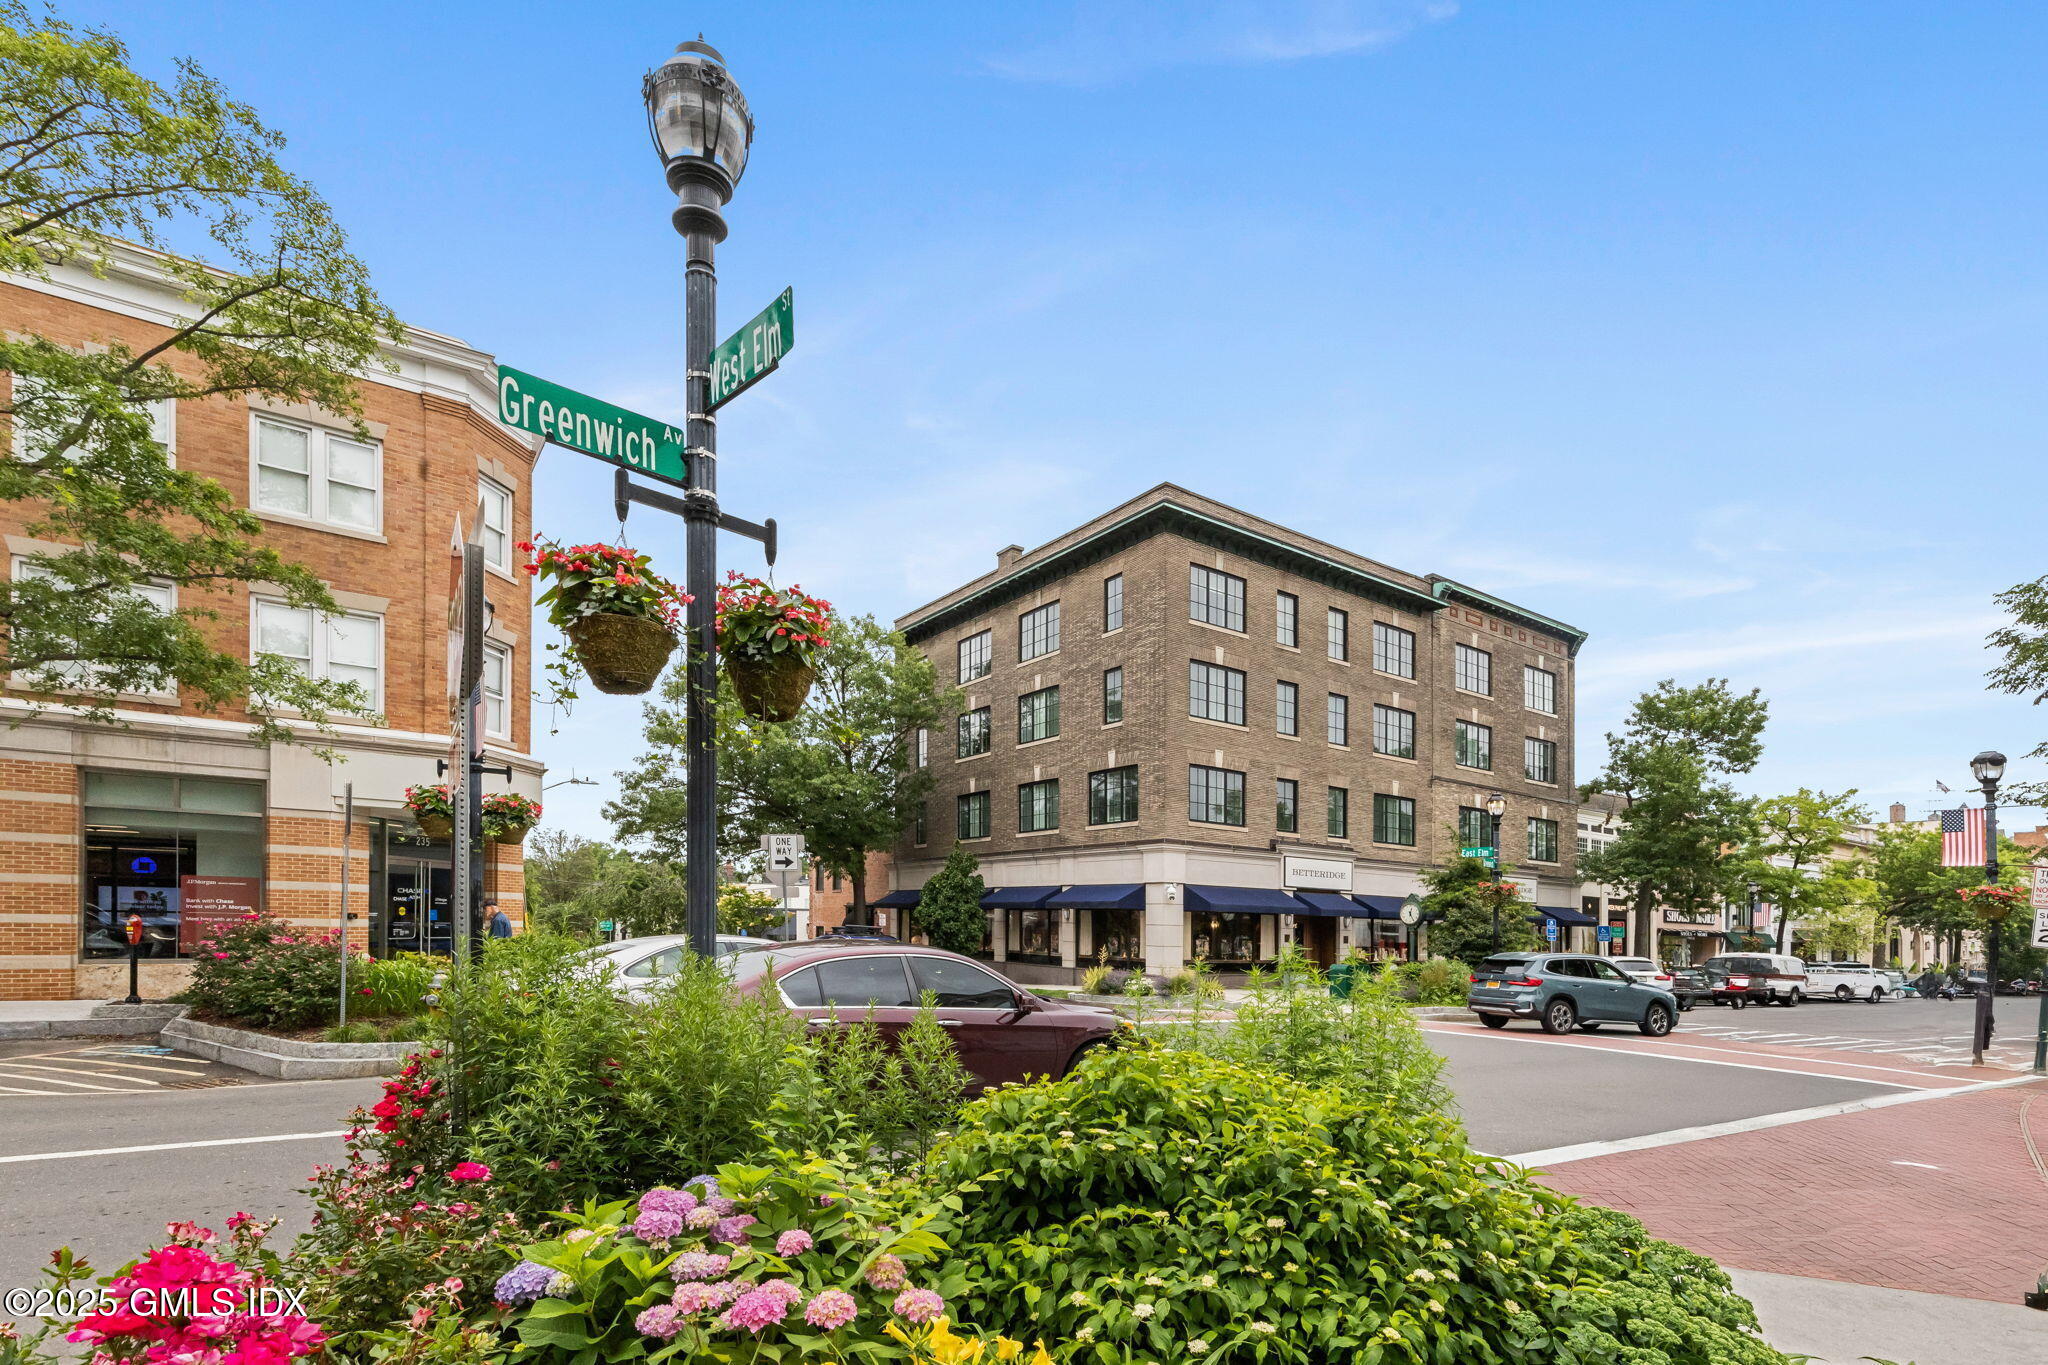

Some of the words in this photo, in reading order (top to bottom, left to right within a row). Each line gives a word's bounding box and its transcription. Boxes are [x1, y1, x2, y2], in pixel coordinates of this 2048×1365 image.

[709, 340, 746, 404] West
[753, 321, 782, 374] Elm
[781, 290, 791, 311] St
[500, 375, 656, 471] Greenwich
[663, 425, 683, 446] Av
[416, 836, 431, 847] 235
[775, 837, 791, 846] ONE
[775, 847, 792, 856] WAY
[1461, 849, 1476, 858] East
[1477, 848, 1489, 857] Elm
[1292, 868, 1346, 880] BETTERIDGE
